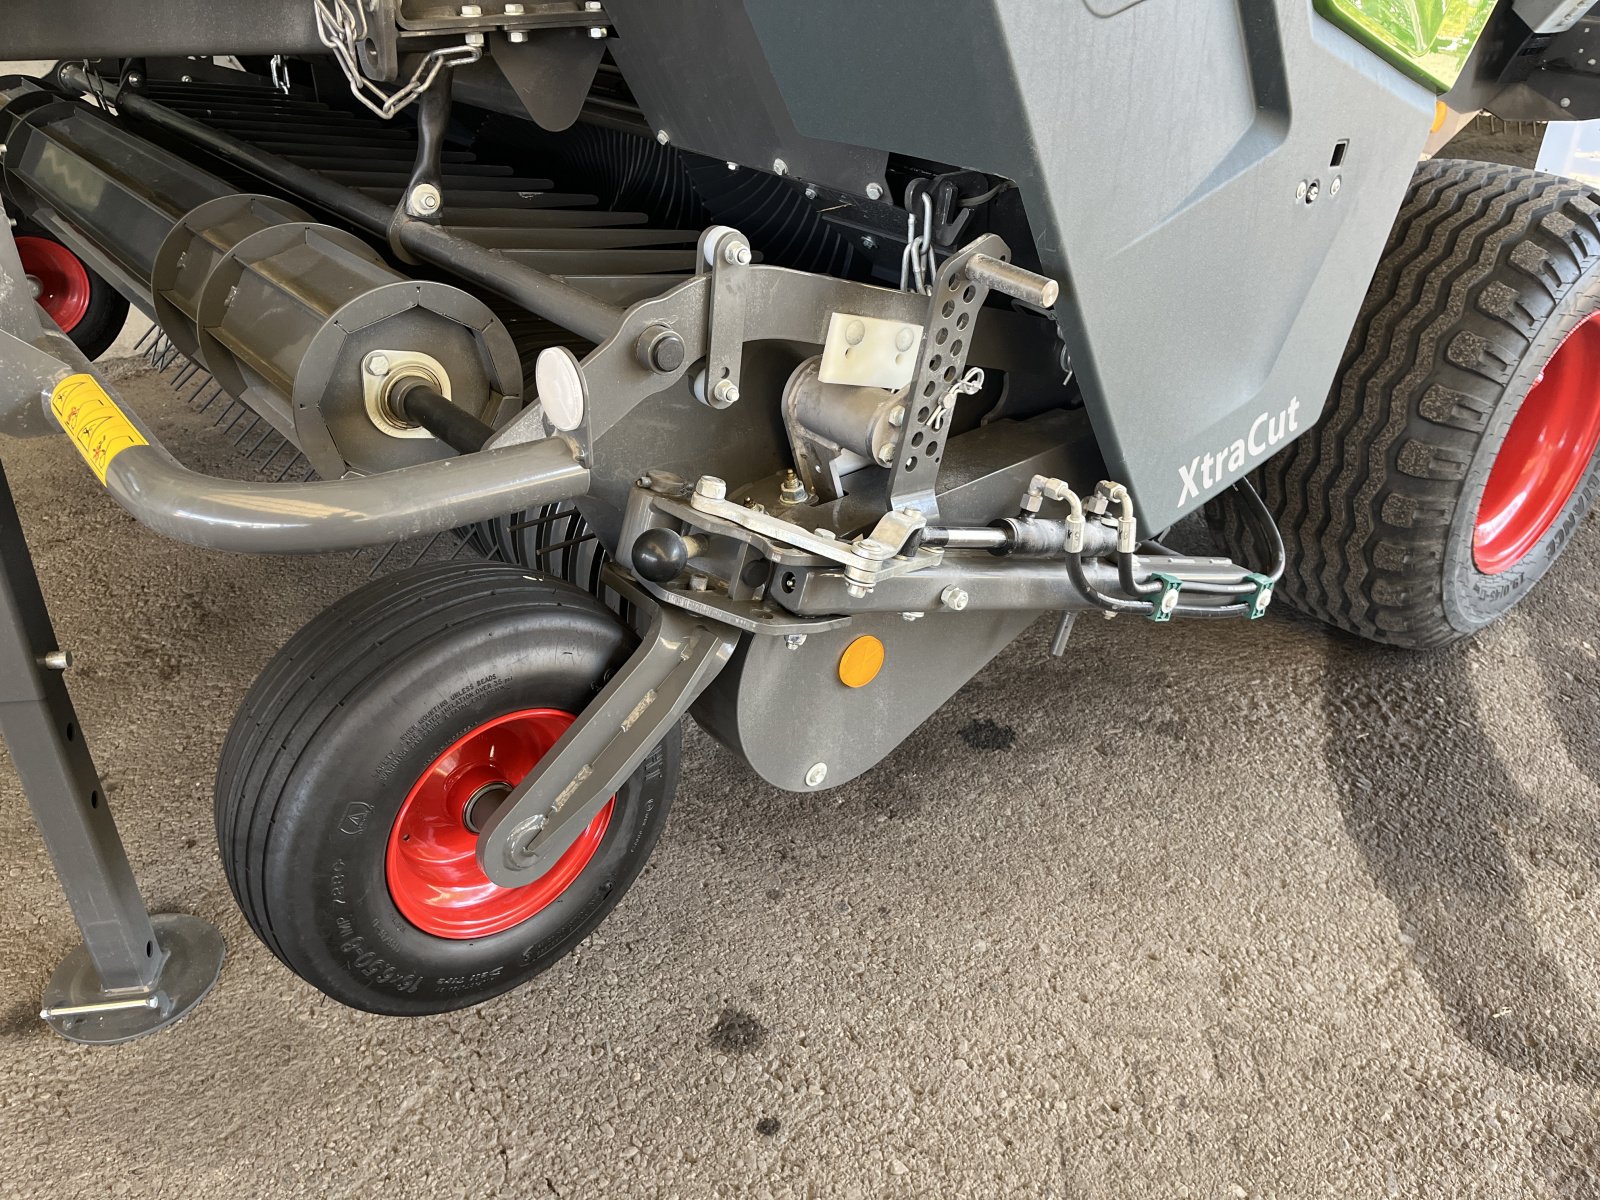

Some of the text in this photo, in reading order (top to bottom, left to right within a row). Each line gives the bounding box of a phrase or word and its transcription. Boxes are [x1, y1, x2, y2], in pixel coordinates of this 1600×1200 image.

[1177, 395, 1300, 508] XtraCut
[418, 713, 441, 733] SEATED
[441, 691, 474, 714] INFLATION
[475, 682, 492, 695] OVER
[451, 683, 475, 701] UNLESS
[477, 673, 497, 687] BEADS
